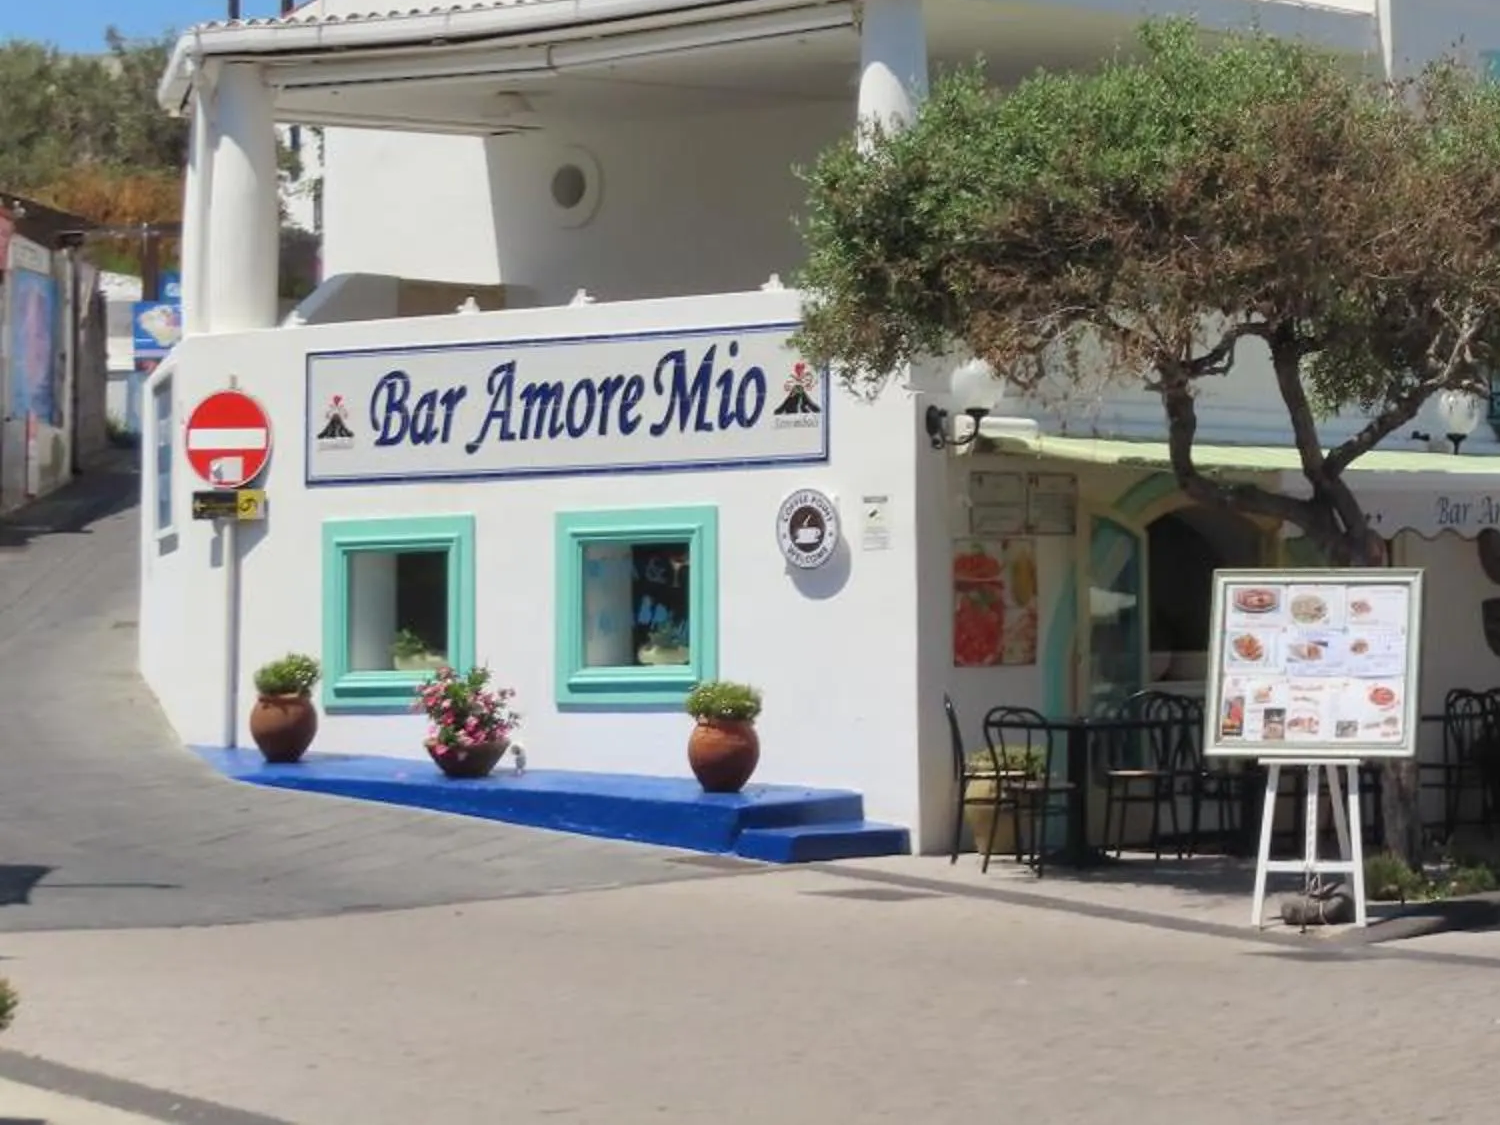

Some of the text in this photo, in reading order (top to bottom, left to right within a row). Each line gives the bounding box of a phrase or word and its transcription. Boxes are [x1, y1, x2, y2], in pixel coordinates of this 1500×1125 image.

[369, 340, 766, 455] Bar Amore Mio
[1437, 496, 1473, 525] Bar
